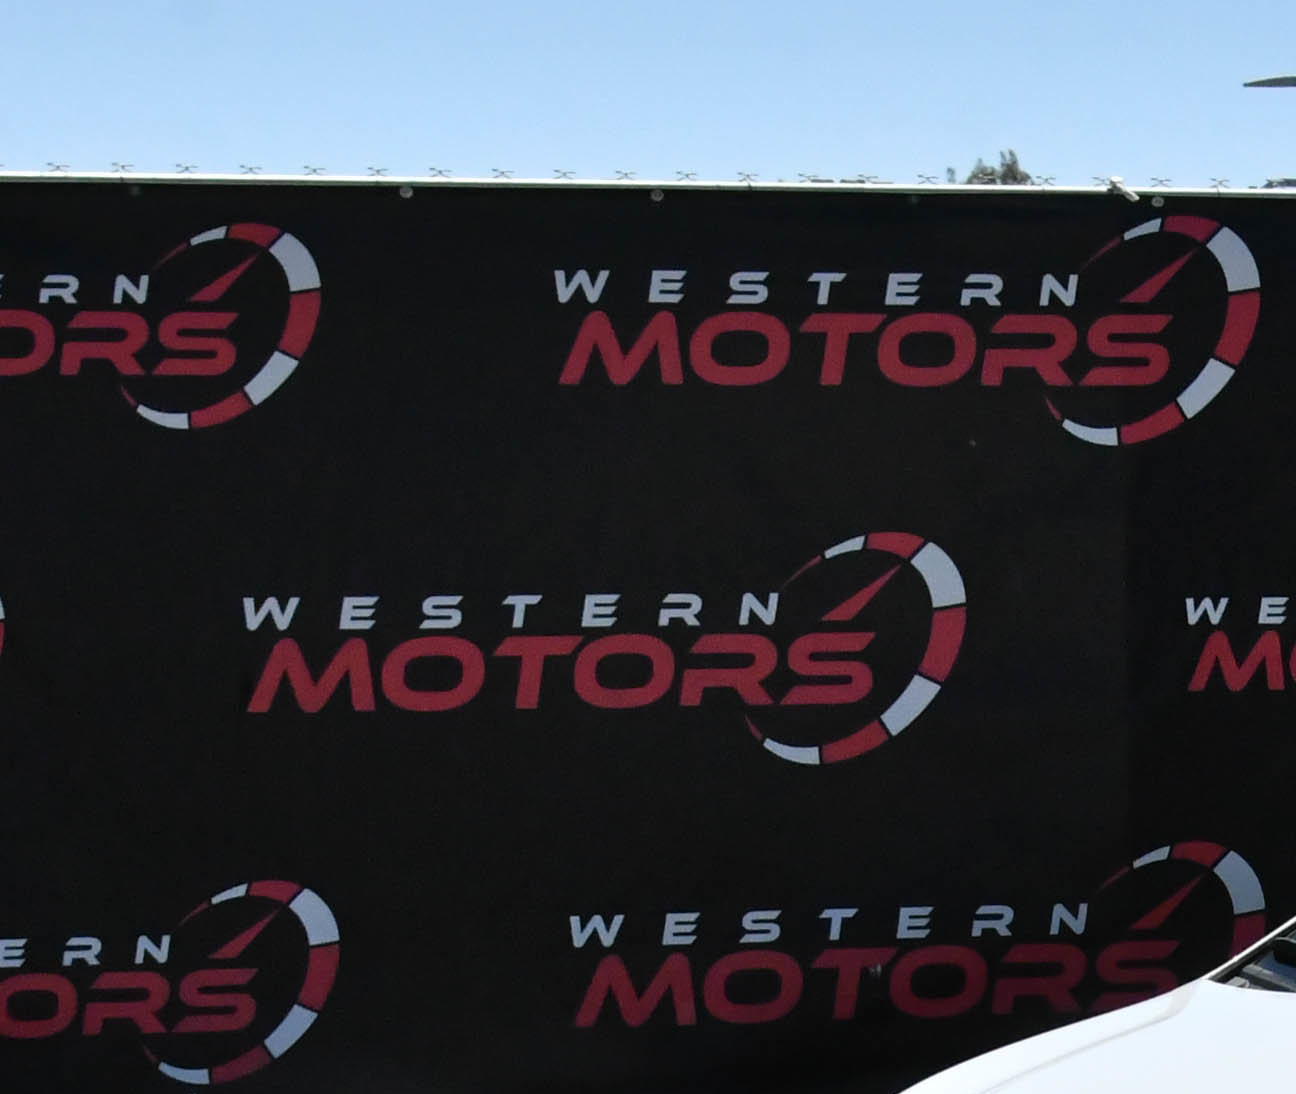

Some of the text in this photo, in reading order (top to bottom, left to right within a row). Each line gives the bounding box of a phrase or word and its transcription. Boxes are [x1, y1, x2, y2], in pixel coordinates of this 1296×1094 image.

[0, 274, 149, 304] RN
[556, 271, 1079, 307] WESTERN
[561, 311, 1173, 388] MOTORS
[245, 594, 779, 631] WESTERN
[249, 633, 875, 713] MOTORS
[571, 905, 1088, 948] WESTERN
[577, 942, 1177, 1028] MOTORS
